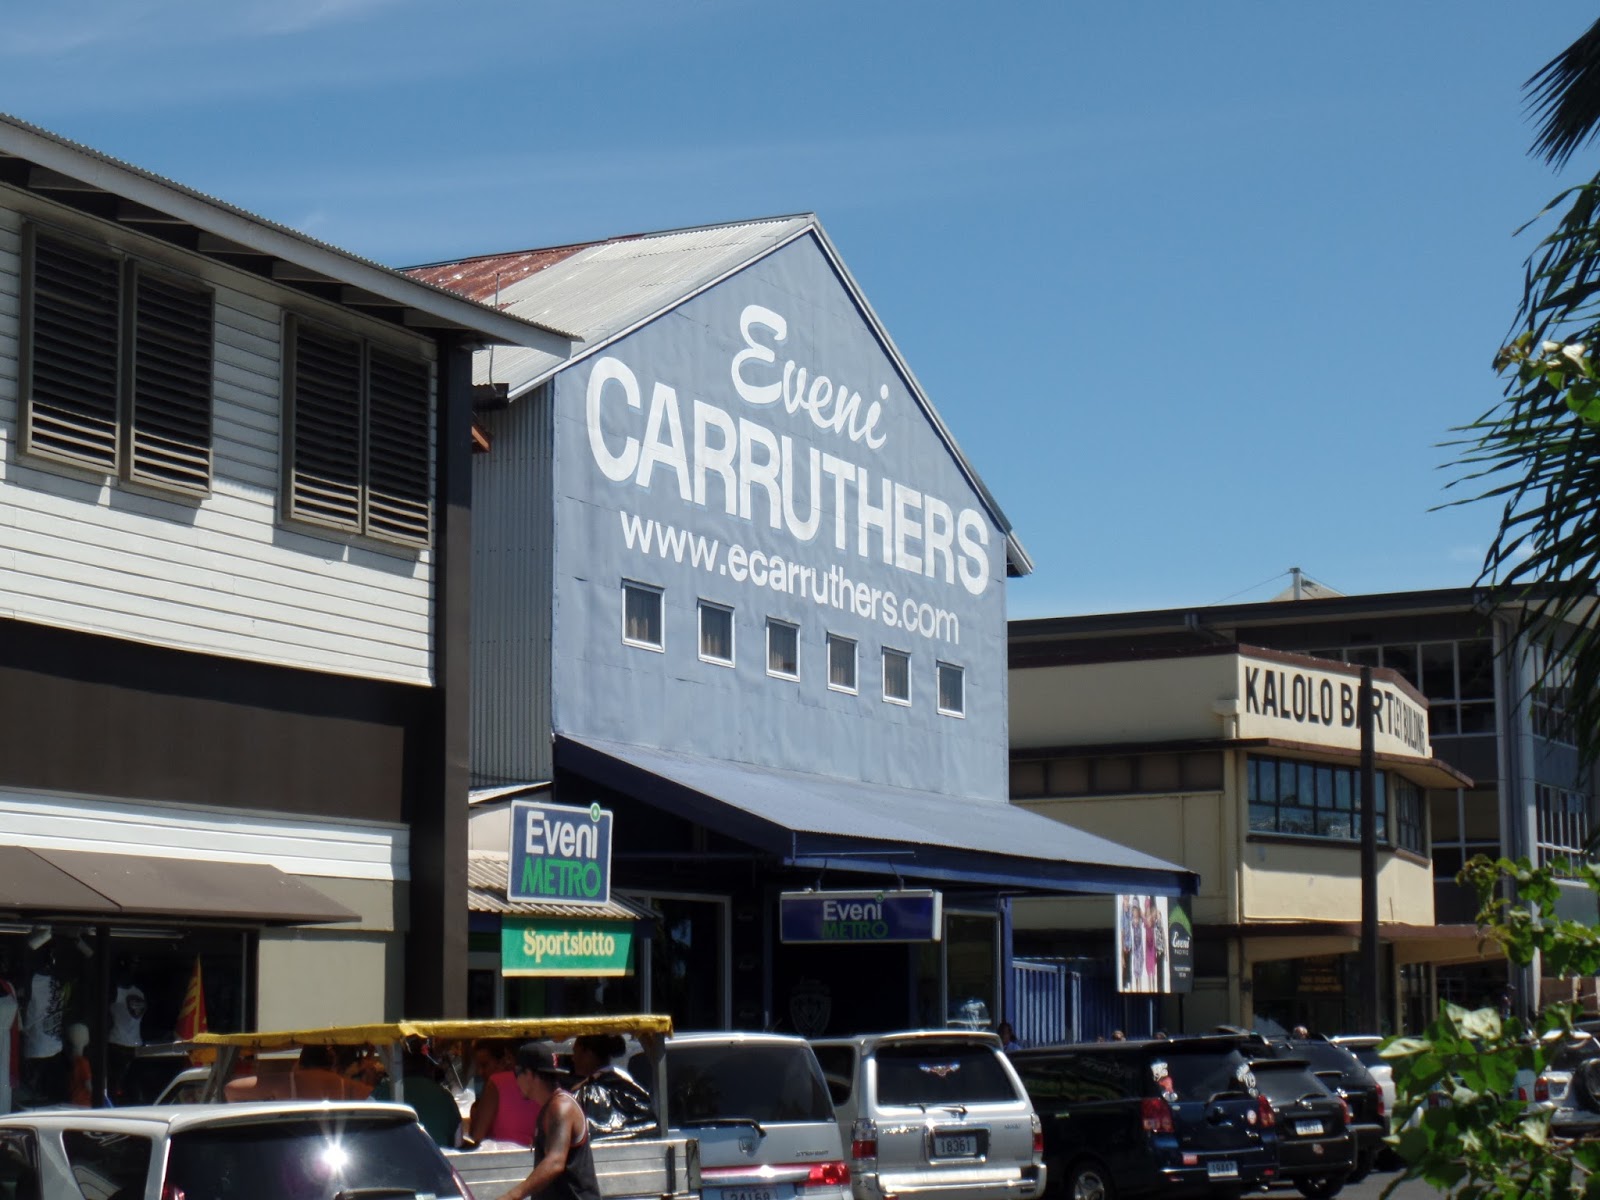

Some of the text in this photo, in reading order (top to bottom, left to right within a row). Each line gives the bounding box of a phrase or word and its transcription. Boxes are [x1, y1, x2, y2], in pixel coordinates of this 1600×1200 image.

[731, 304, 889, 449] Eveni
[586, 356, 990, 595] CARRUTHERS
[619, 510, 960, 645] www.ecarruthers.com
[1245, 666, 1334, 727] KALOLO
[525, 803, 600, 859] Eveni
[521, 856, 602, 898] METRO
[821, 920, 889, 939] METRO
[822, 892, 883, 921] Eveni
[523, 927, 616, 964] Sportslotto
[940, 1139, 971, 1153] 18361
